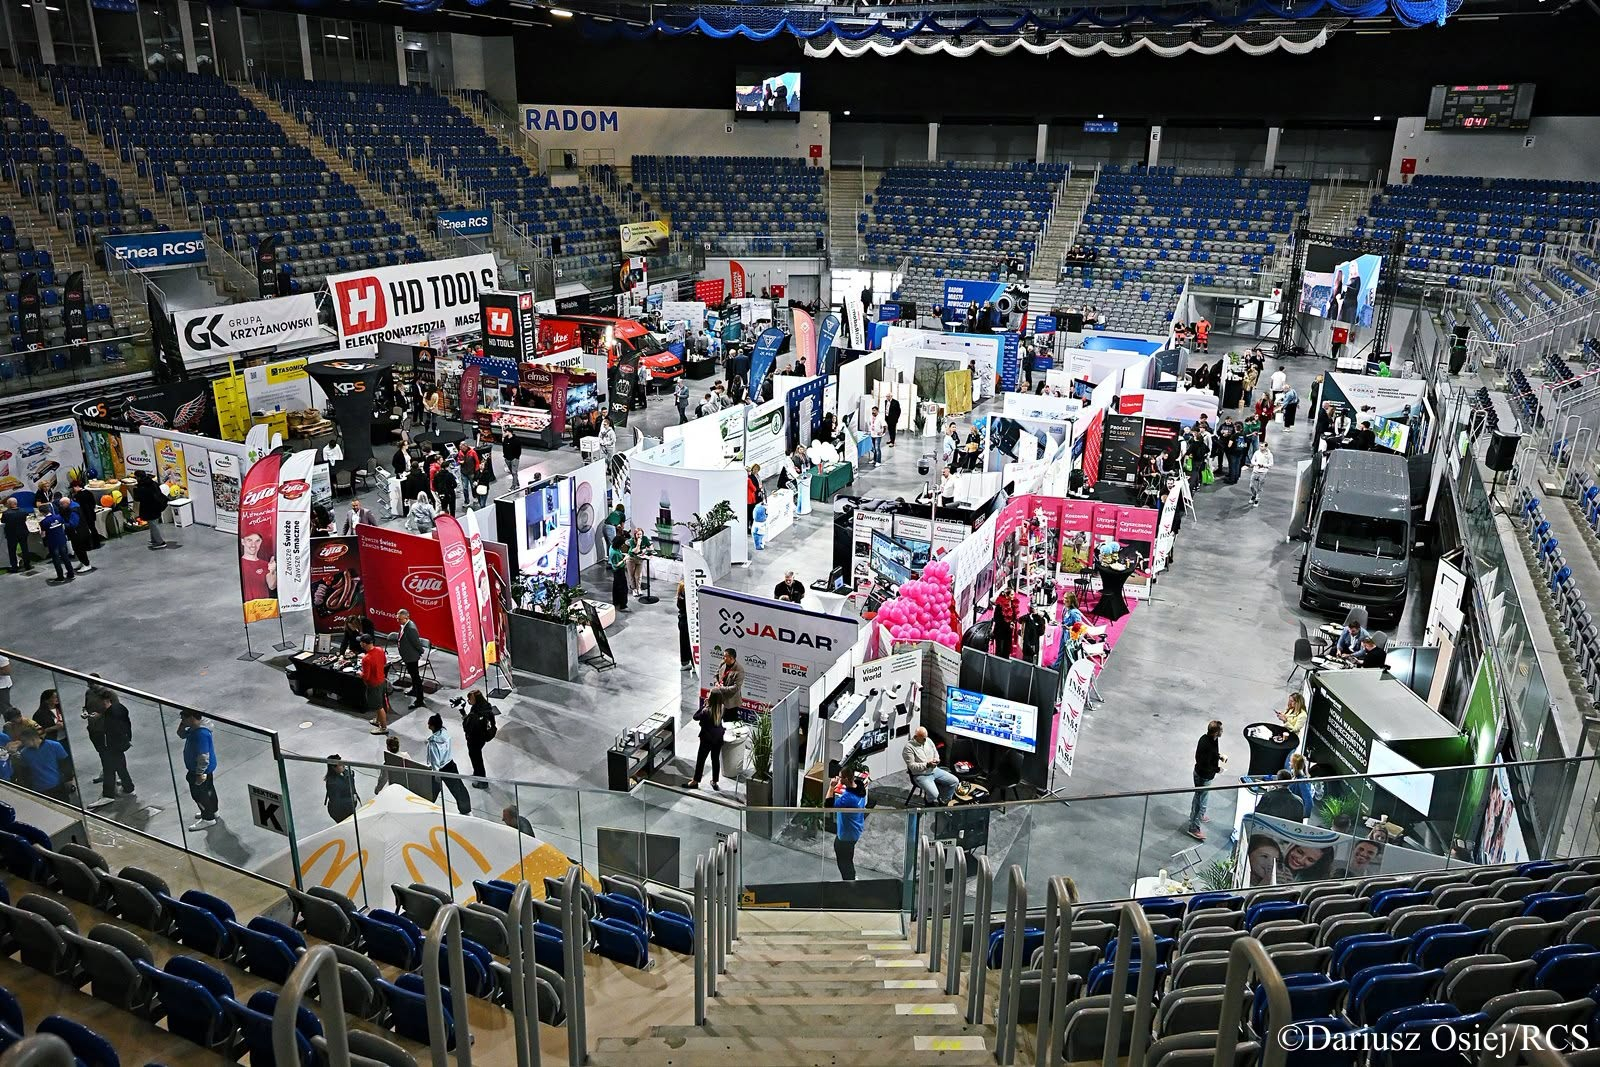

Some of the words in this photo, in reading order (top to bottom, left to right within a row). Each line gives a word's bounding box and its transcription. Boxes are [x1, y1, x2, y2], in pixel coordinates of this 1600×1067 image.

[525, 108, 619, 132] RADOM
[468, 216, 488, 228] RCS
[115, 245, 158, 260] Enea
[162, 241, 196, 256] RCS
[389, 279, 425, 317] HD
[427, 268, 494, 310] TOOLS
[228, 314, 262, 328] GRUPA
[454, 312, 480, 327] MASZ
[523, 313, 532, 330] HD
[230, 317, 313, 341] KRZYŻANOWSKI
[488, 338, 496, 346] HD
[497, 339, 515, 348] TOOLS
[523, 330, 535, 362] TOOLS
[278, 363, 304, 375] TASOMIX
[527, 370, 550, 382] elmas
[333, 381, 366, 392] KPS
[466, 377, 474, 399] elmas
[863, 514, 890, 523] Interfach
[1119, 520, 1153, 529] Czyszczenie
[282, 520, 292, 548] Świeże
[292, 520, 300, 554] Smaczne
[380, 544, 403, 555] Smaczne
[285, 548, 293, 576] Zawsze
[293, 555, 302, 583] Zawsze
[745, 622, 833, 651] JADAR
[744, 655, 767, 666] JADAR
[782, 667, 807, 678] BLOCK
[862, 664, 882, 676] Vision
[862, 671, 882, 683] World
[1329, 707, 1343, 726] NOWA
[1343, 720, 1367, 748] WARSTWA
[257, 799, 284, 833] K
